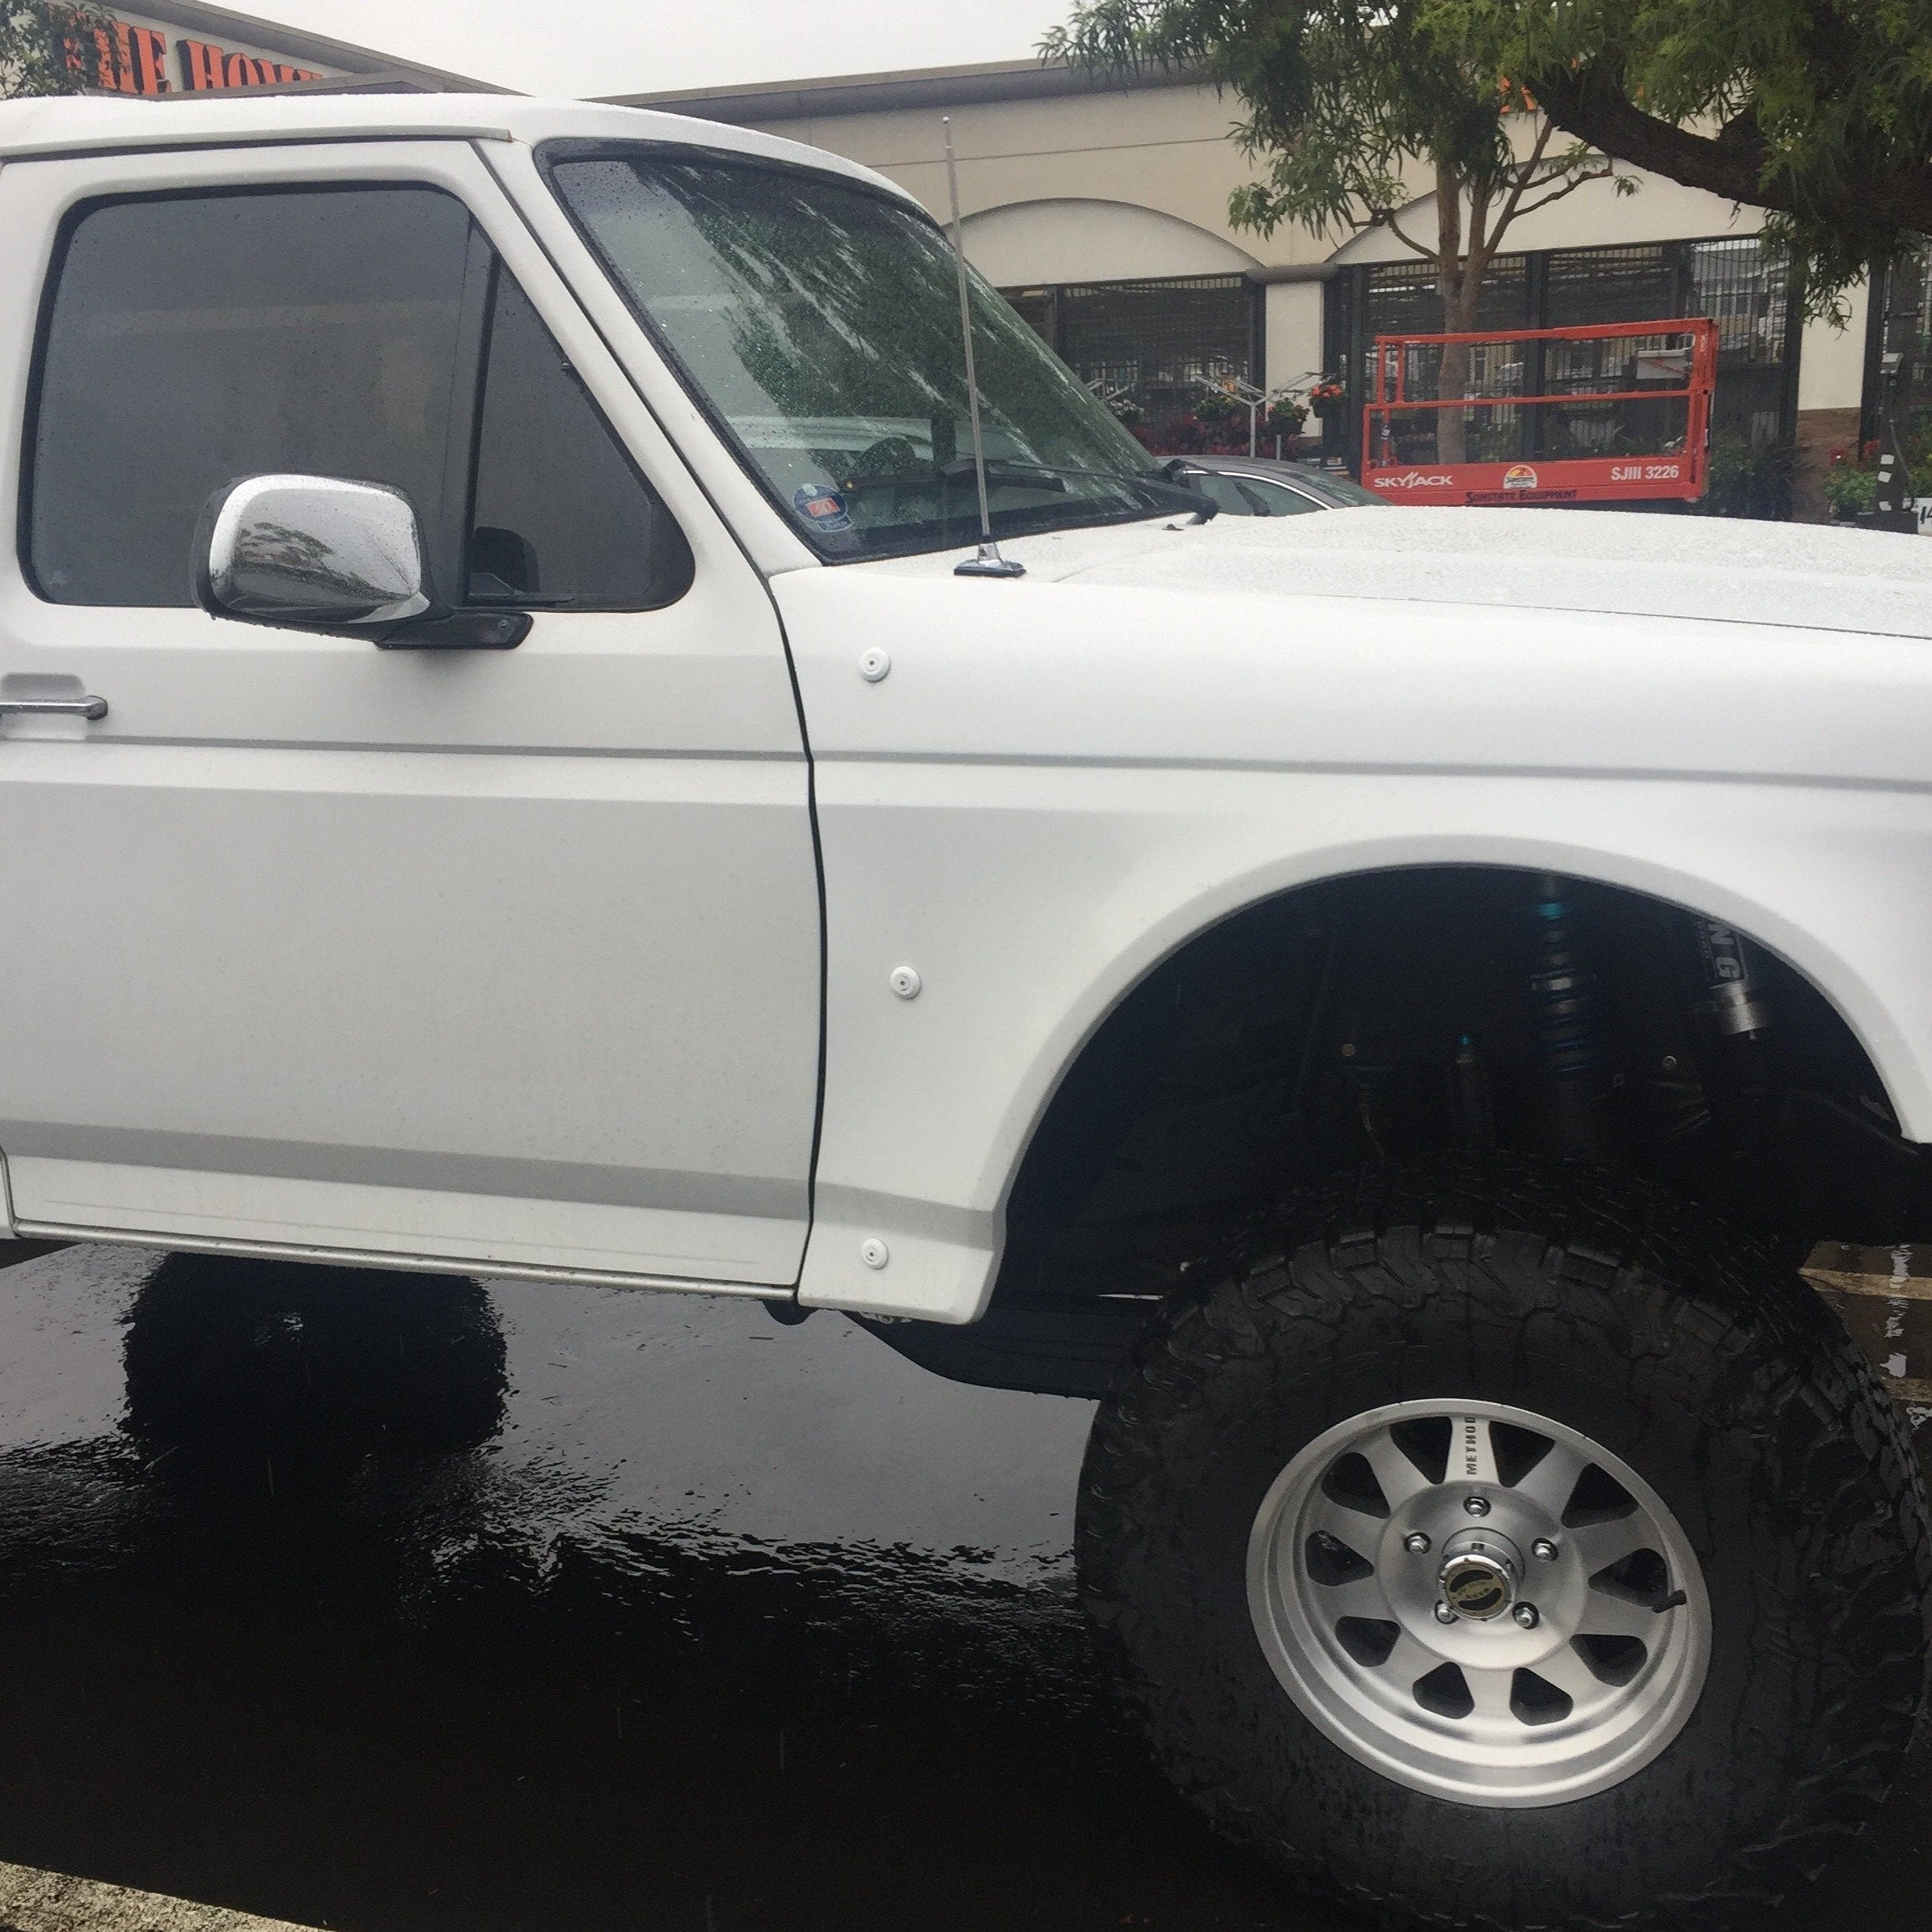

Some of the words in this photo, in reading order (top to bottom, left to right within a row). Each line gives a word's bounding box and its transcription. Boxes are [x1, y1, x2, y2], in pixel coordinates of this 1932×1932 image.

[1374, 471, 1453, 488] SKYJACK
[1645, 464, 1680, 480] 3226
[1464, 1416, 1478, 1475] METHOD
